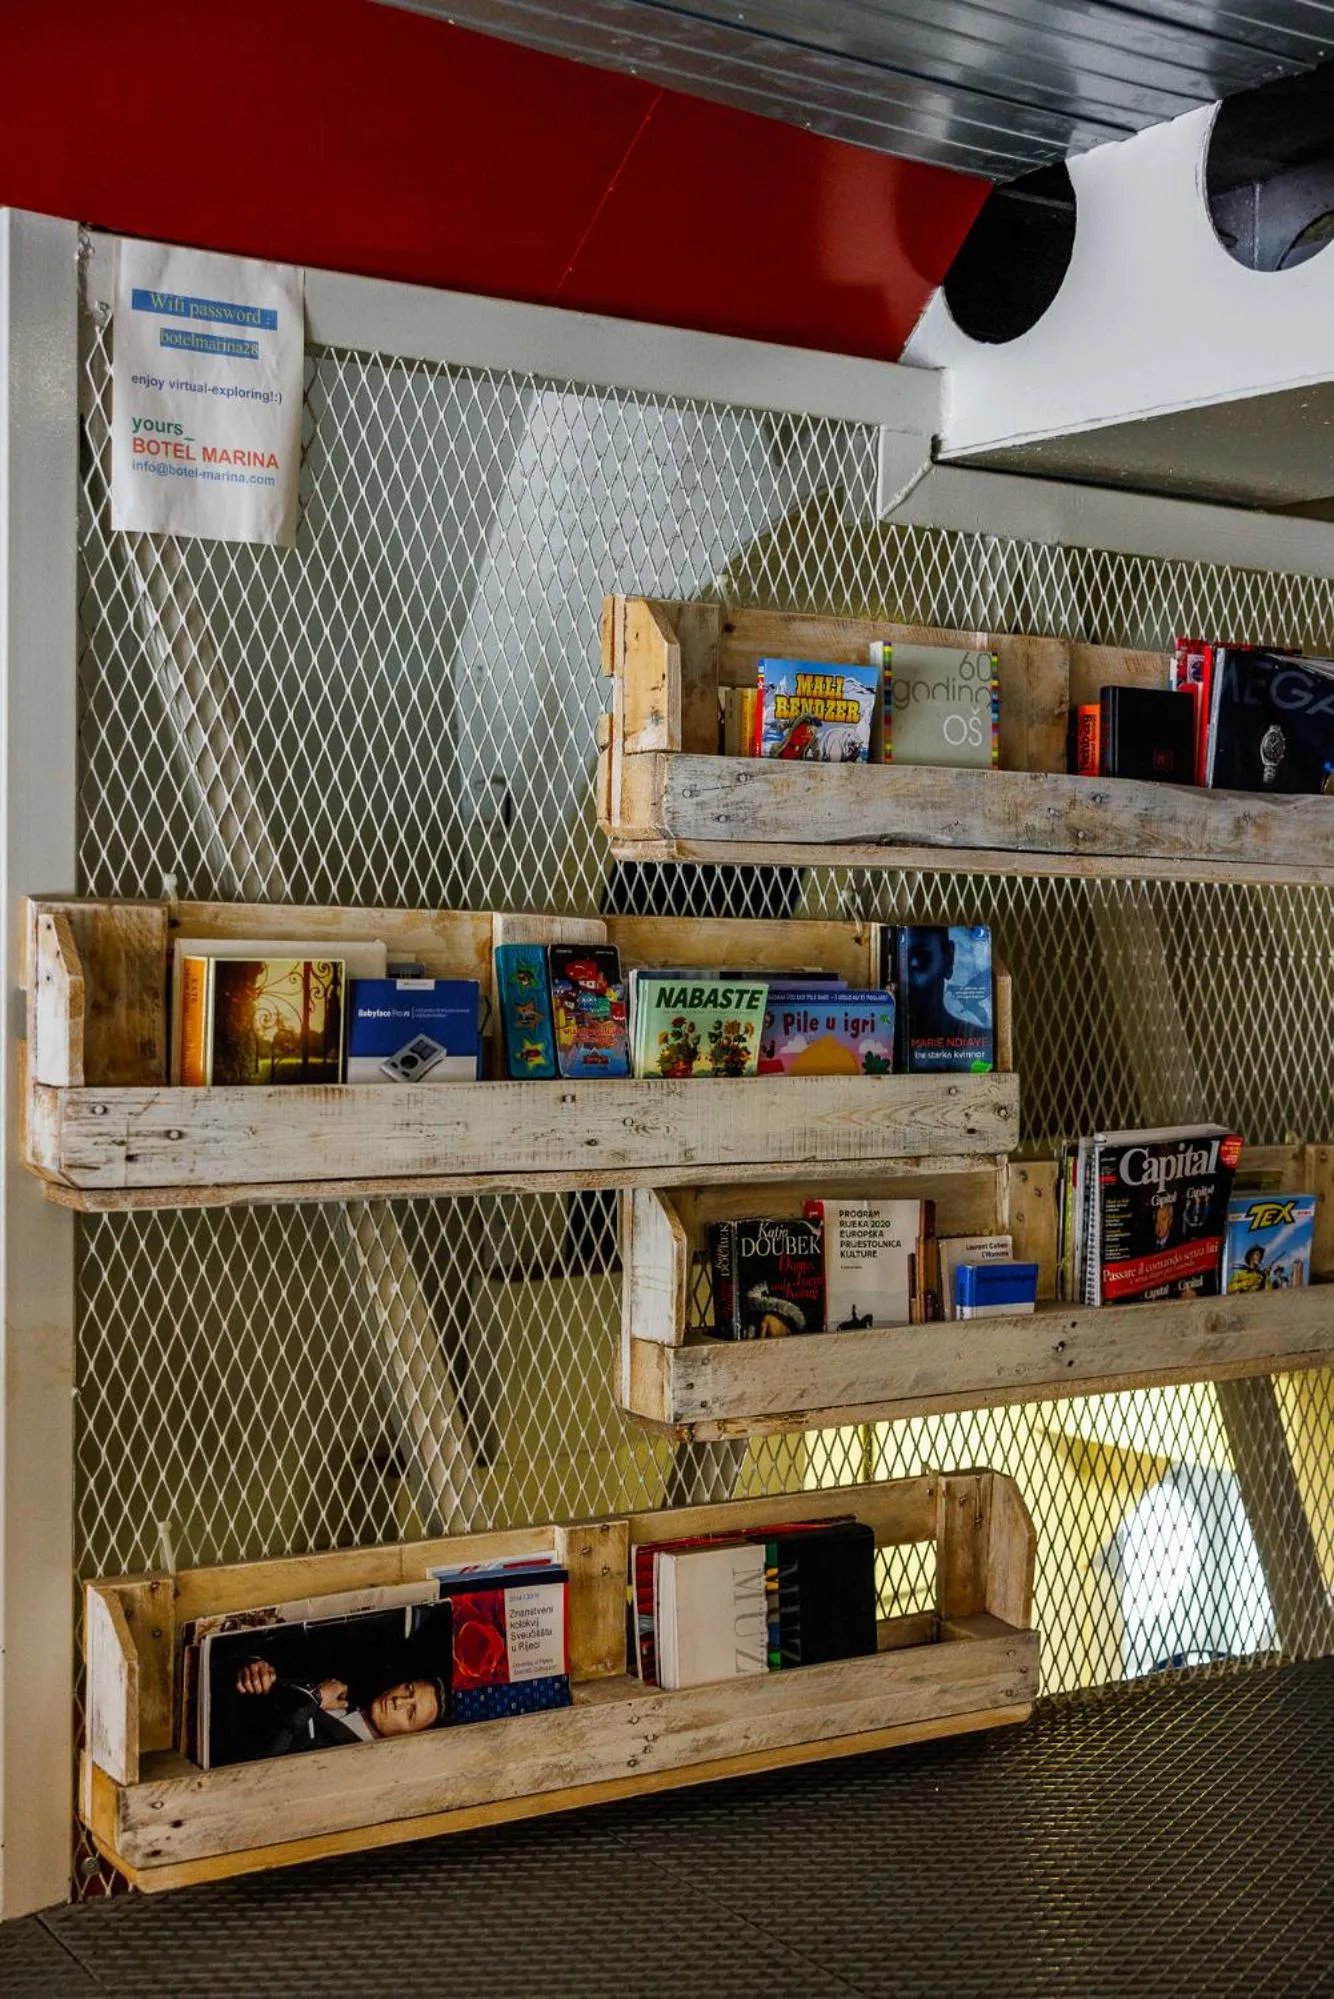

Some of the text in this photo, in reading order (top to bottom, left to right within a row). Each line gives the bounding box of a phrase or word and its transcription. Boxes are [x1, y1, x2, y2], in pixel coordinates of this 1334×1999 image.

[149, 292, 186, 310] Wifi
[189, 303, 261, 325] password
[160, 327, 259, 359] botelmarina28
[131, 374, 165, 391] enjoy
[131, 437, 280, 470] BOTEL MARINA
[131, 461, 276, 487] info@botel-marina.com
[959, 651, 992, 683] 60
[796, 673, 844, 699] MALI
[655, 987, 764, 1010] NABASTE
[358, 1008, 391, 1019] Babyface
[783, 1010, 820, 1037] Pile
[826, 1015, 837, 1031] u
[844, 1011, 876, 1040] igri
[911, 1037, 945, 1048] MARIE
[1119, 1140, 1221, 1195] Capital
[839, 1209, 881, 1218] PROGRAM
[870, 1219, 891, 1228] 2020
[1247, 1200, 1299, 1232] TEX
[758, 1222, 789, 1241] Katja
[839, 1229, 884, 1238] EUROPSKA
[742, 1235, 822, 1258] DOUBEK
[840, 1250, 878, 1259] KULTURE
